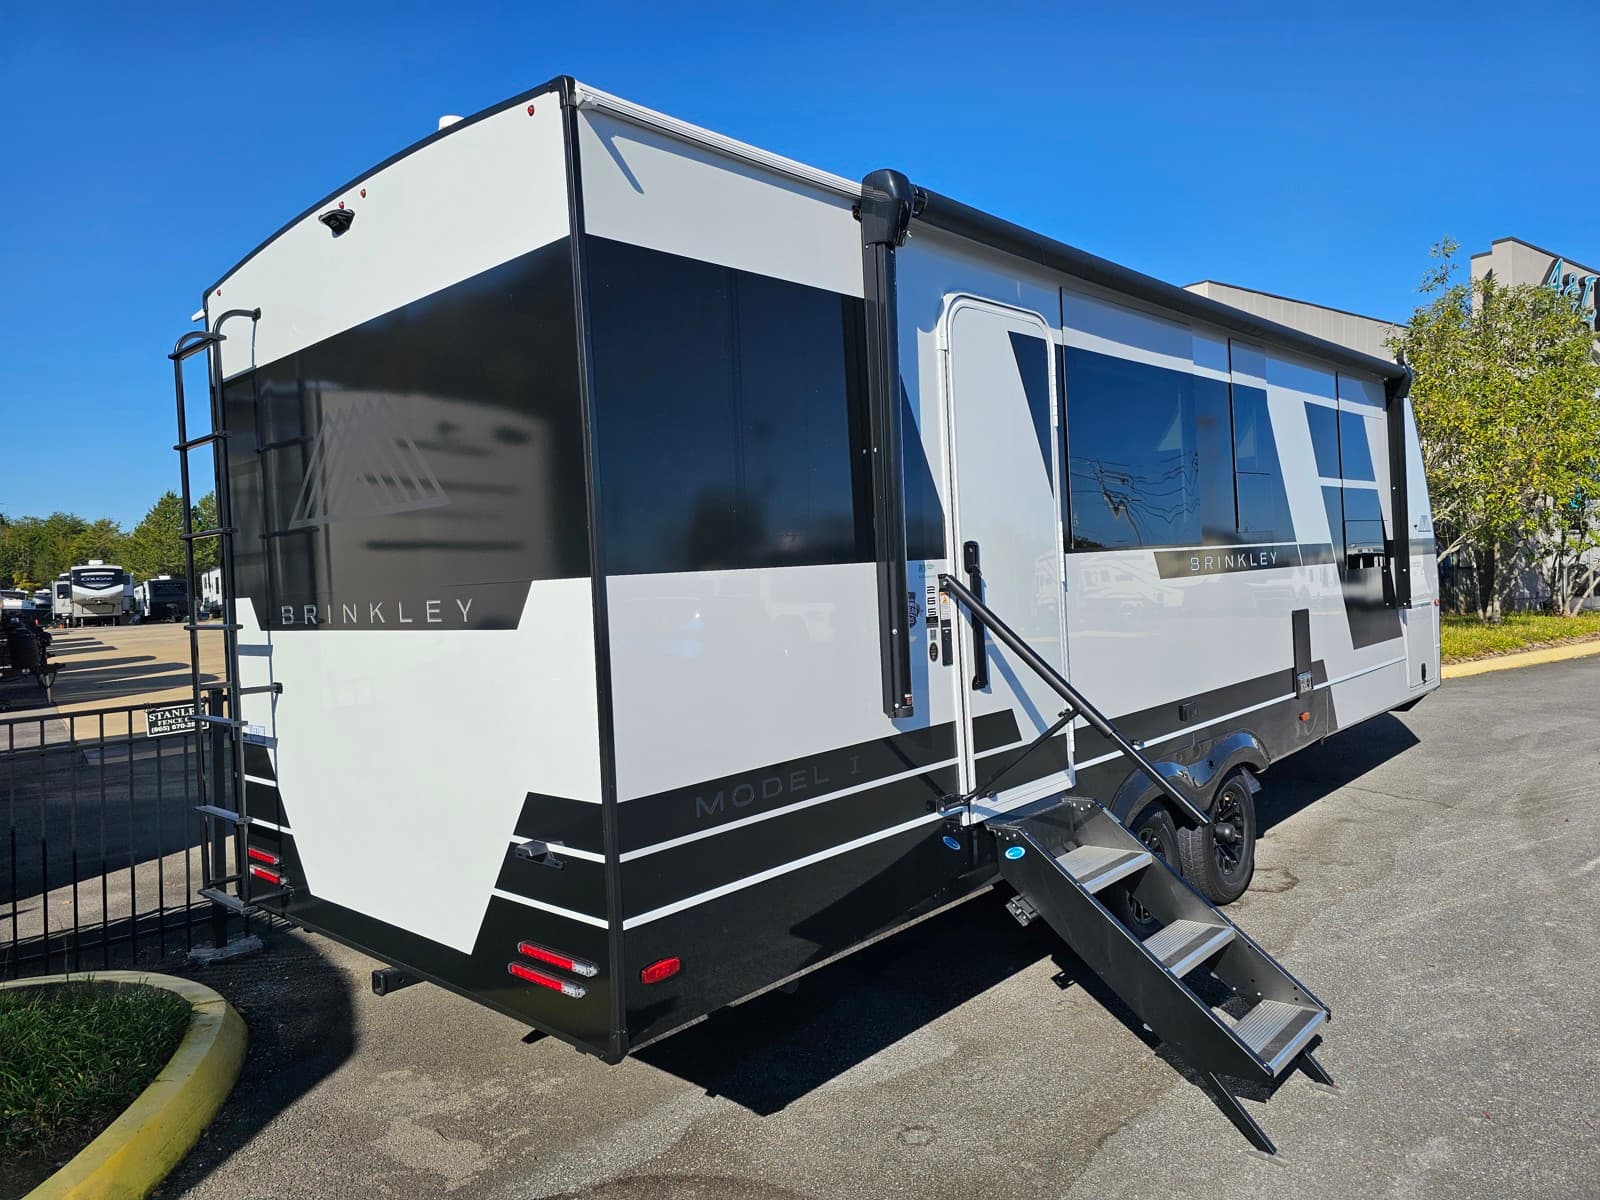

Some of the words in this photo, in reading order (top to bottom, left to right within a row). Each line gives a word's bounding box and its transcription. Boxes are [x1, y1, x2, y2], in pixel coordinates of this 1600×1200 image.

[1190, 551, 1277, 571] BRINKLEY
[281, 598, 473, 625] BRINKLEY
[157, 718, 183, 726] FENCE
[695, 766, 830, 818] MODEL
[850, 755, 863, 775] I
